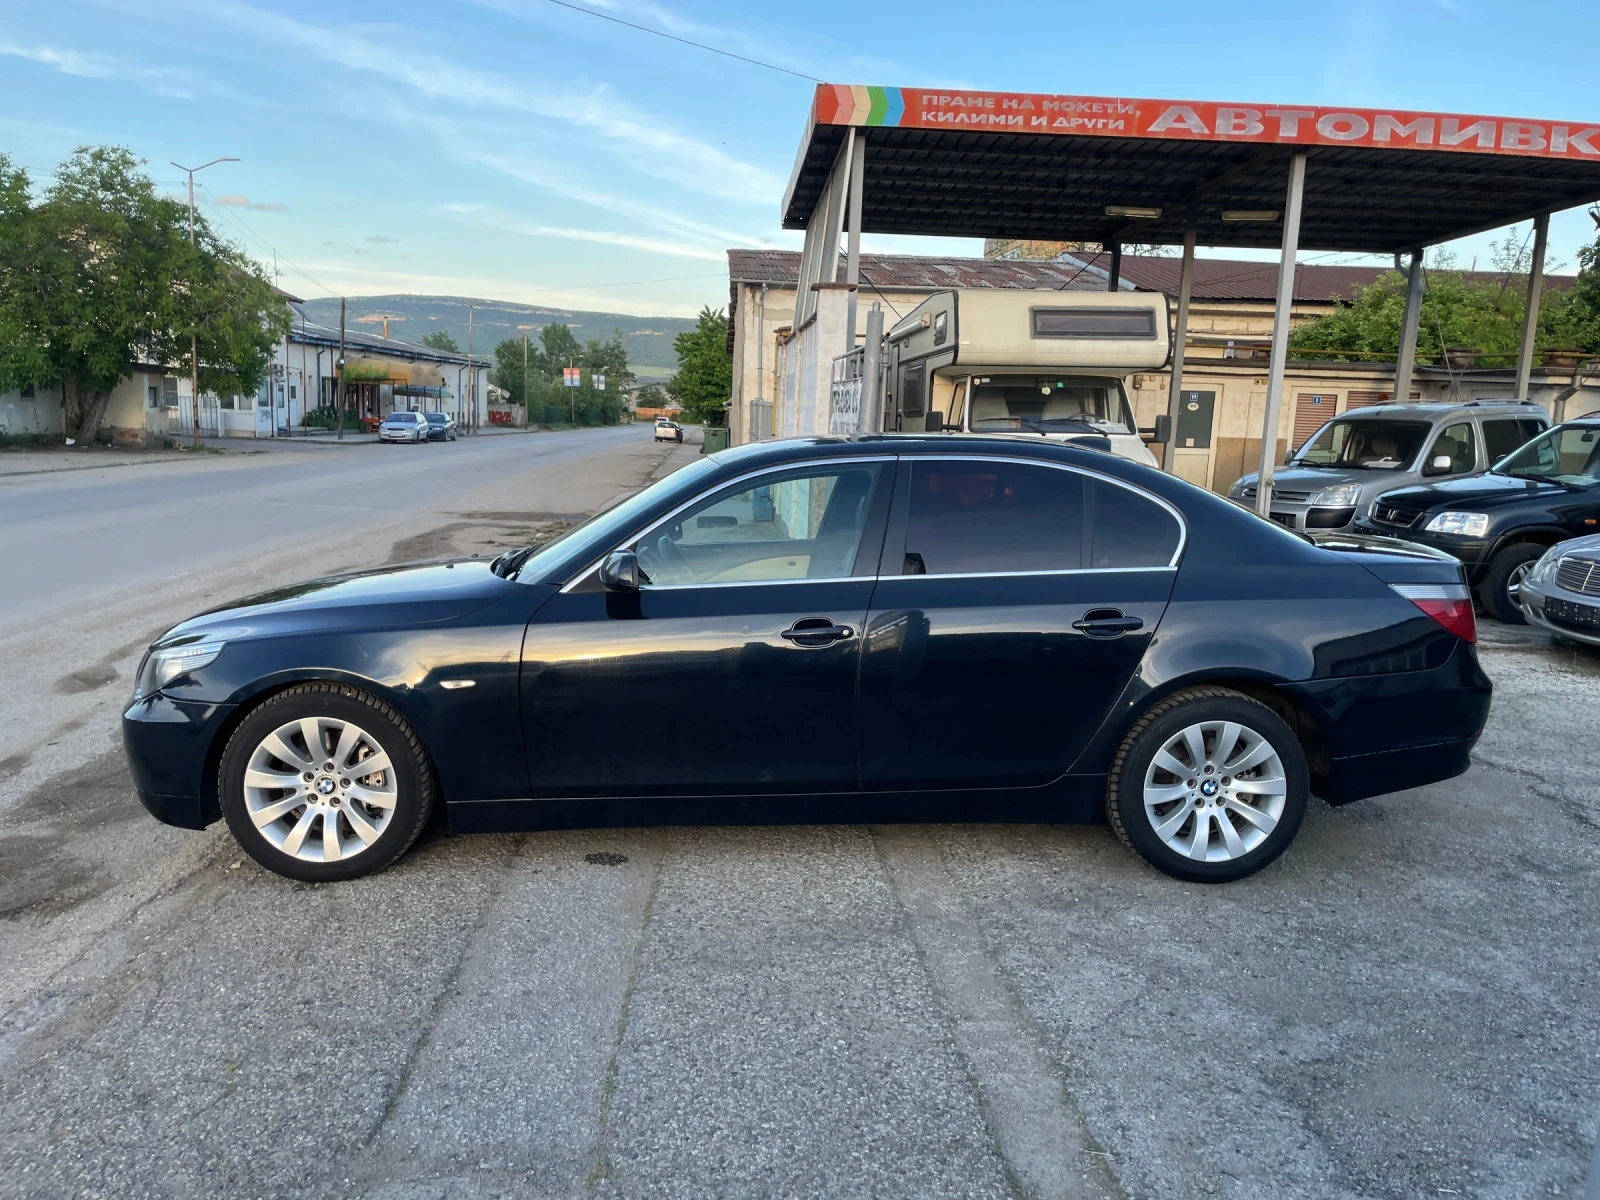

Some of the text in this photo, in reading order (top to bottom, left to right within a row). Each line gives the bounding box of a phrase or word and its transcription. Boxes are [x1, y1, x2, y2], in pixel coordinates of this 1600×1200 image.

[922, 95, 1141, 117] ПРАНЕ НА МОКЕТИ,
[921, 111, 1125, 130] КИЛИМИ И ДРУГИ
[1146, 105, 1600, 154] АВТОМИВК
